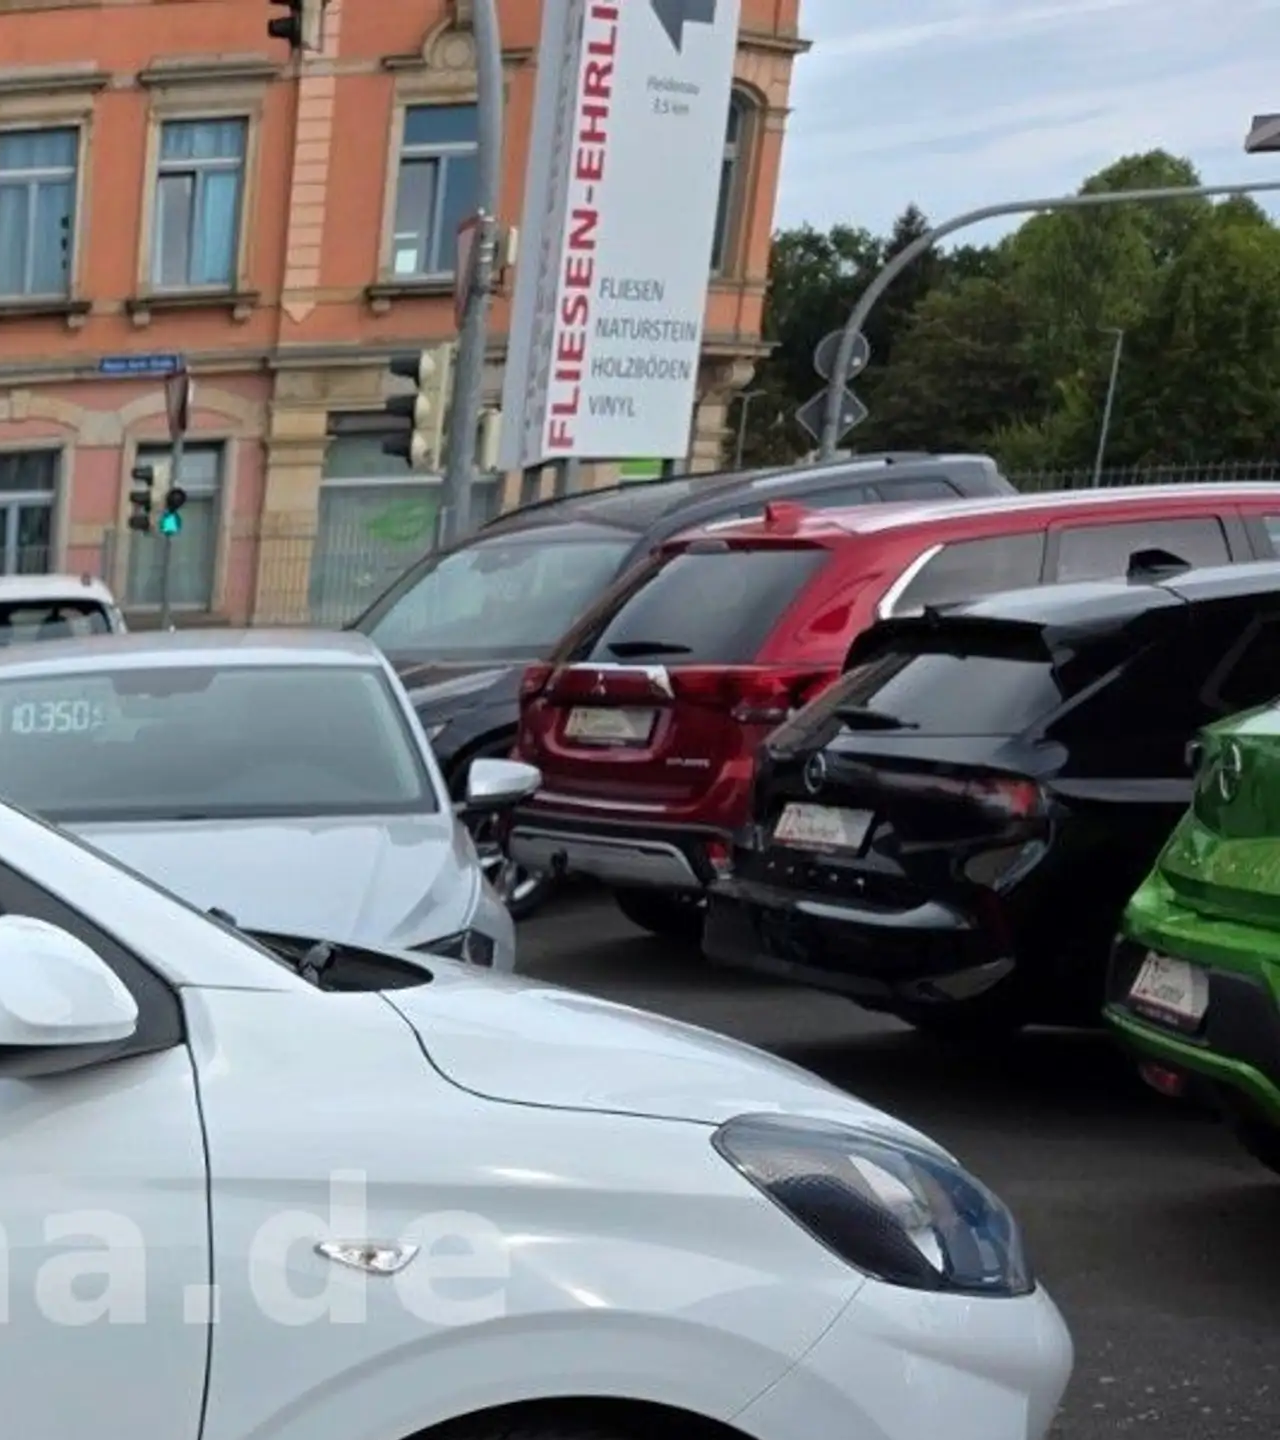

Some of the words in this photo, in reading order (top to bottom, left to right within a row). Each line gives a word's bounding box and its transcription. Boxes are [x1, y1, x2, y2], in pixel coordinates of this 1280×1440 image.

[548, 0, 619, 449] FLIESEN-EHRLI
[599, 277, 665, 302] FLIESEN
[595, 317, 697, 342] NATURSTEIN
[591, 355, 691, 381] HOLZBÖDEN
[589, 395, 635, 418] VINYL
